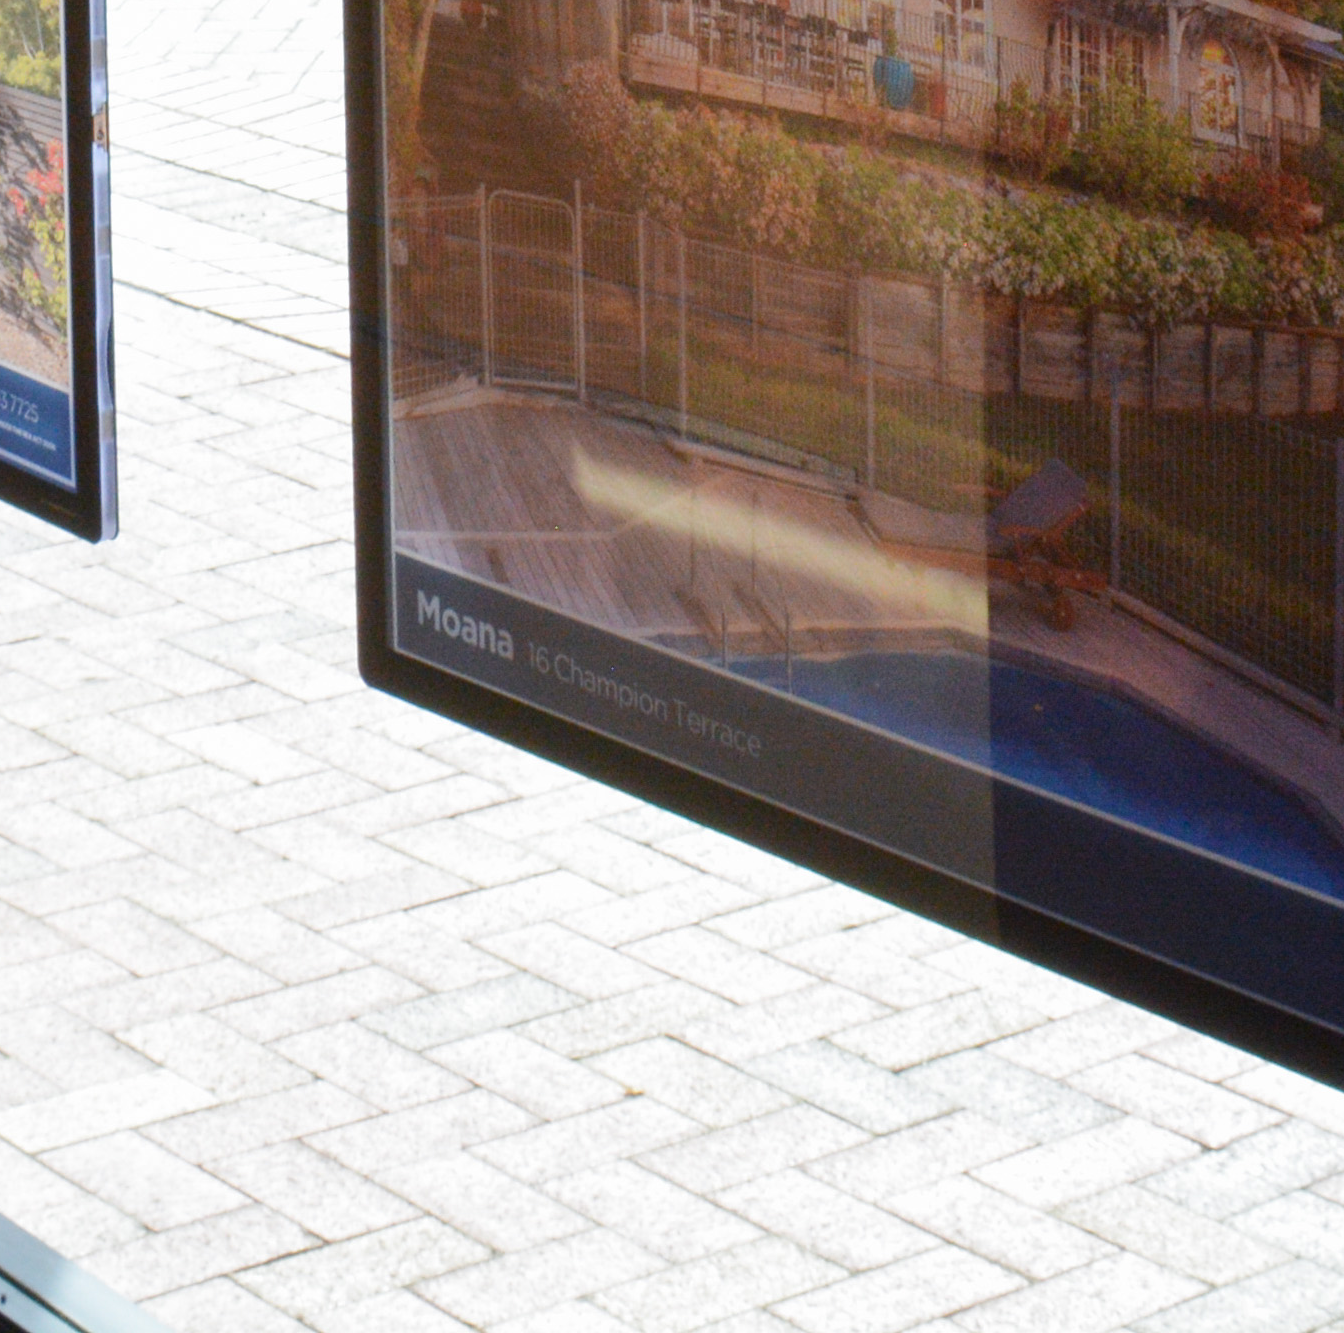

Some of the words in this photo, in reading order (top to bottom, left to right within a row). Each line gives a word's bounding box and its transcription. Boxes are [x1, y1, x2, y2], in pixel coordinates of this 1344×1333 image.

[416, 589, 515, 661] Moana
[529, 641, 549, 675] 16
[554, 653, 669, 718] Champion
[672, 697, 763, 757] Terrace
